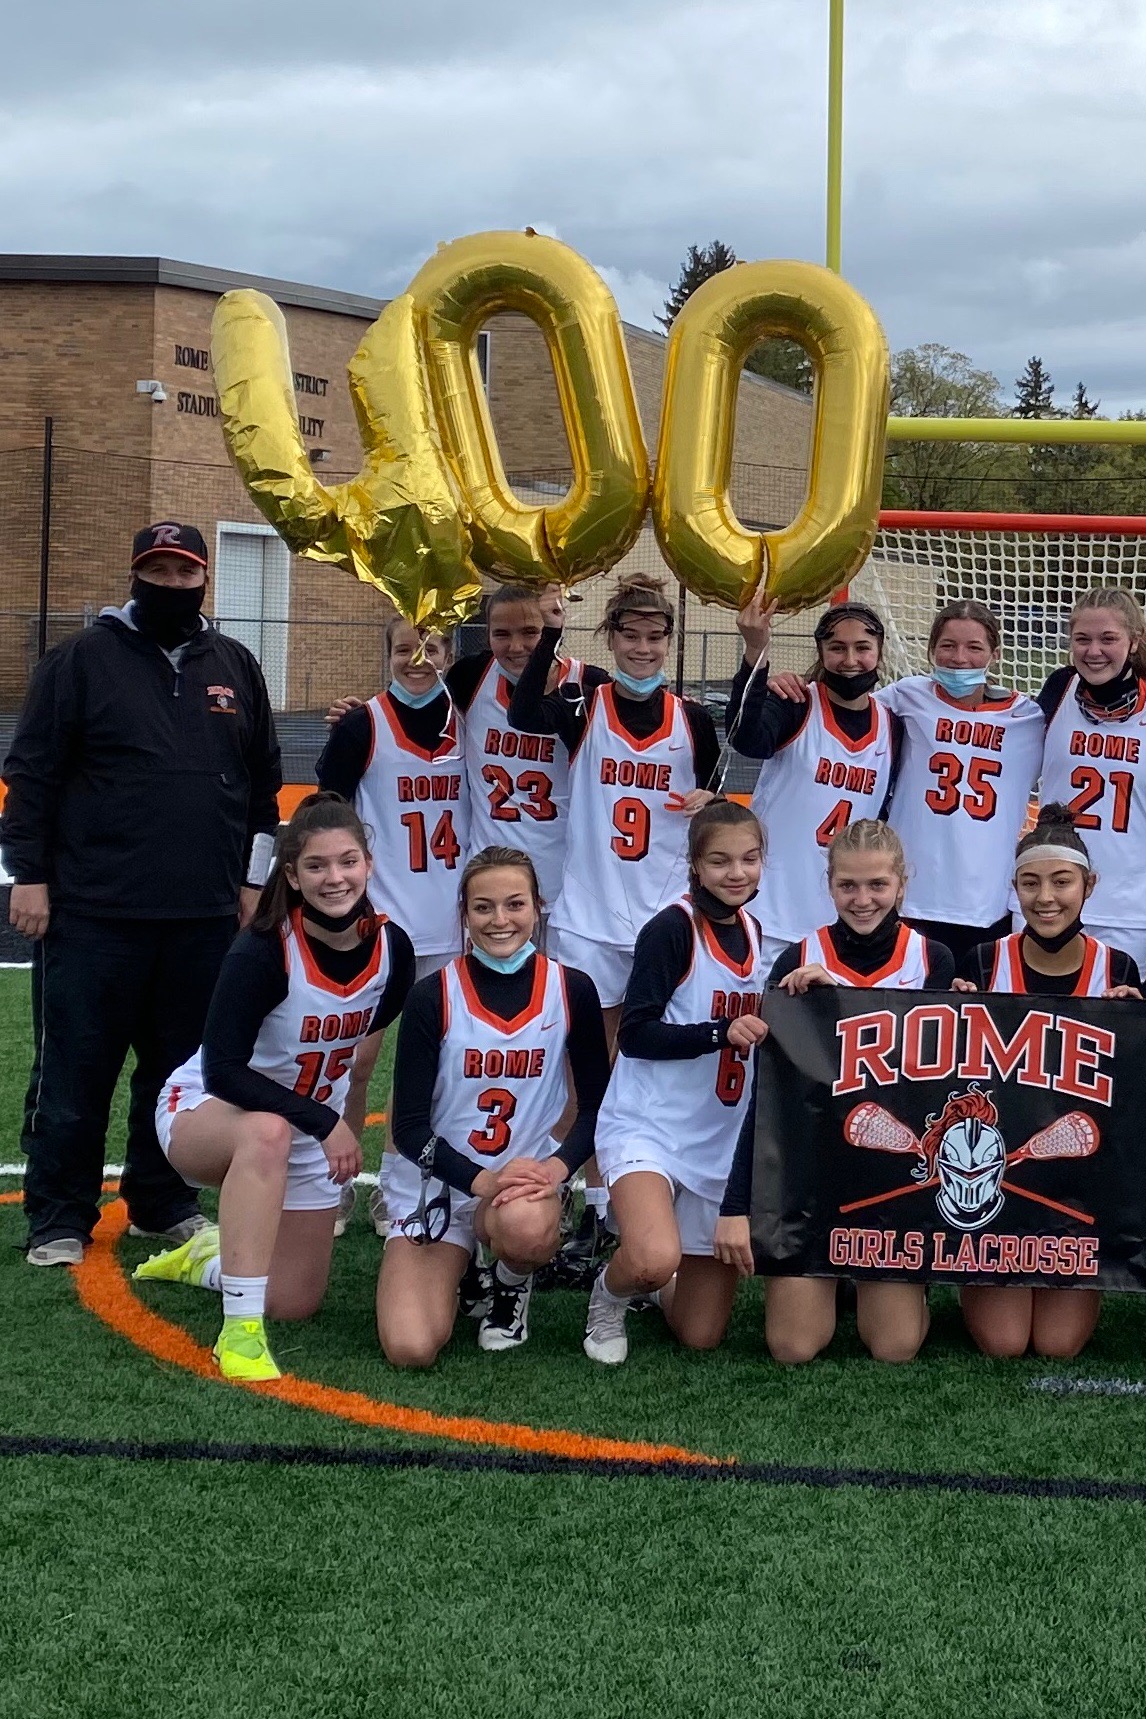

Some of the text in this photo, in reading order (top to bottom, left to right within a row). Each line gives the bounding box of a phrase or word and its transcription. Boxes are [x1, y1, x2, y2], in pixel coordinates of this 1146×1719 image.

[174, 344, 329, 397] ROME STRICT
[177, 391, 325, 439] STADIU ILITY
[152, 525, 181, 546] R
[485, 728, 555, 763] ROME
[935, 718, 1006, 751] ROME
[1070, 731, 1140, 763] ROME
[397, 775, 461, 802] ROME
[481, 764, 557, 822] 23
[600, 758, 672, 791] ROME
[815, 757, 877, 795] ROME
[925, 752, 1002, 821] 35
[816, 799, 853, 847] 4
[1066, 766, 1134, 833] 21
[400, 810, 461, 873] 14
[611, 797, 651, 861] 9
[300, 1007, 373, 1043] ROME
[293, 1043, 358, 1102] 15
[464, 1048, 546, 1079] ROME
[715, 1044, 747, 1107] 6
[831, 1003, 1116, 1108] ROME
[467, 1088, 517, 1157] 3
[829, 1227, 1100, 1276] GIRLS LACROSSE
